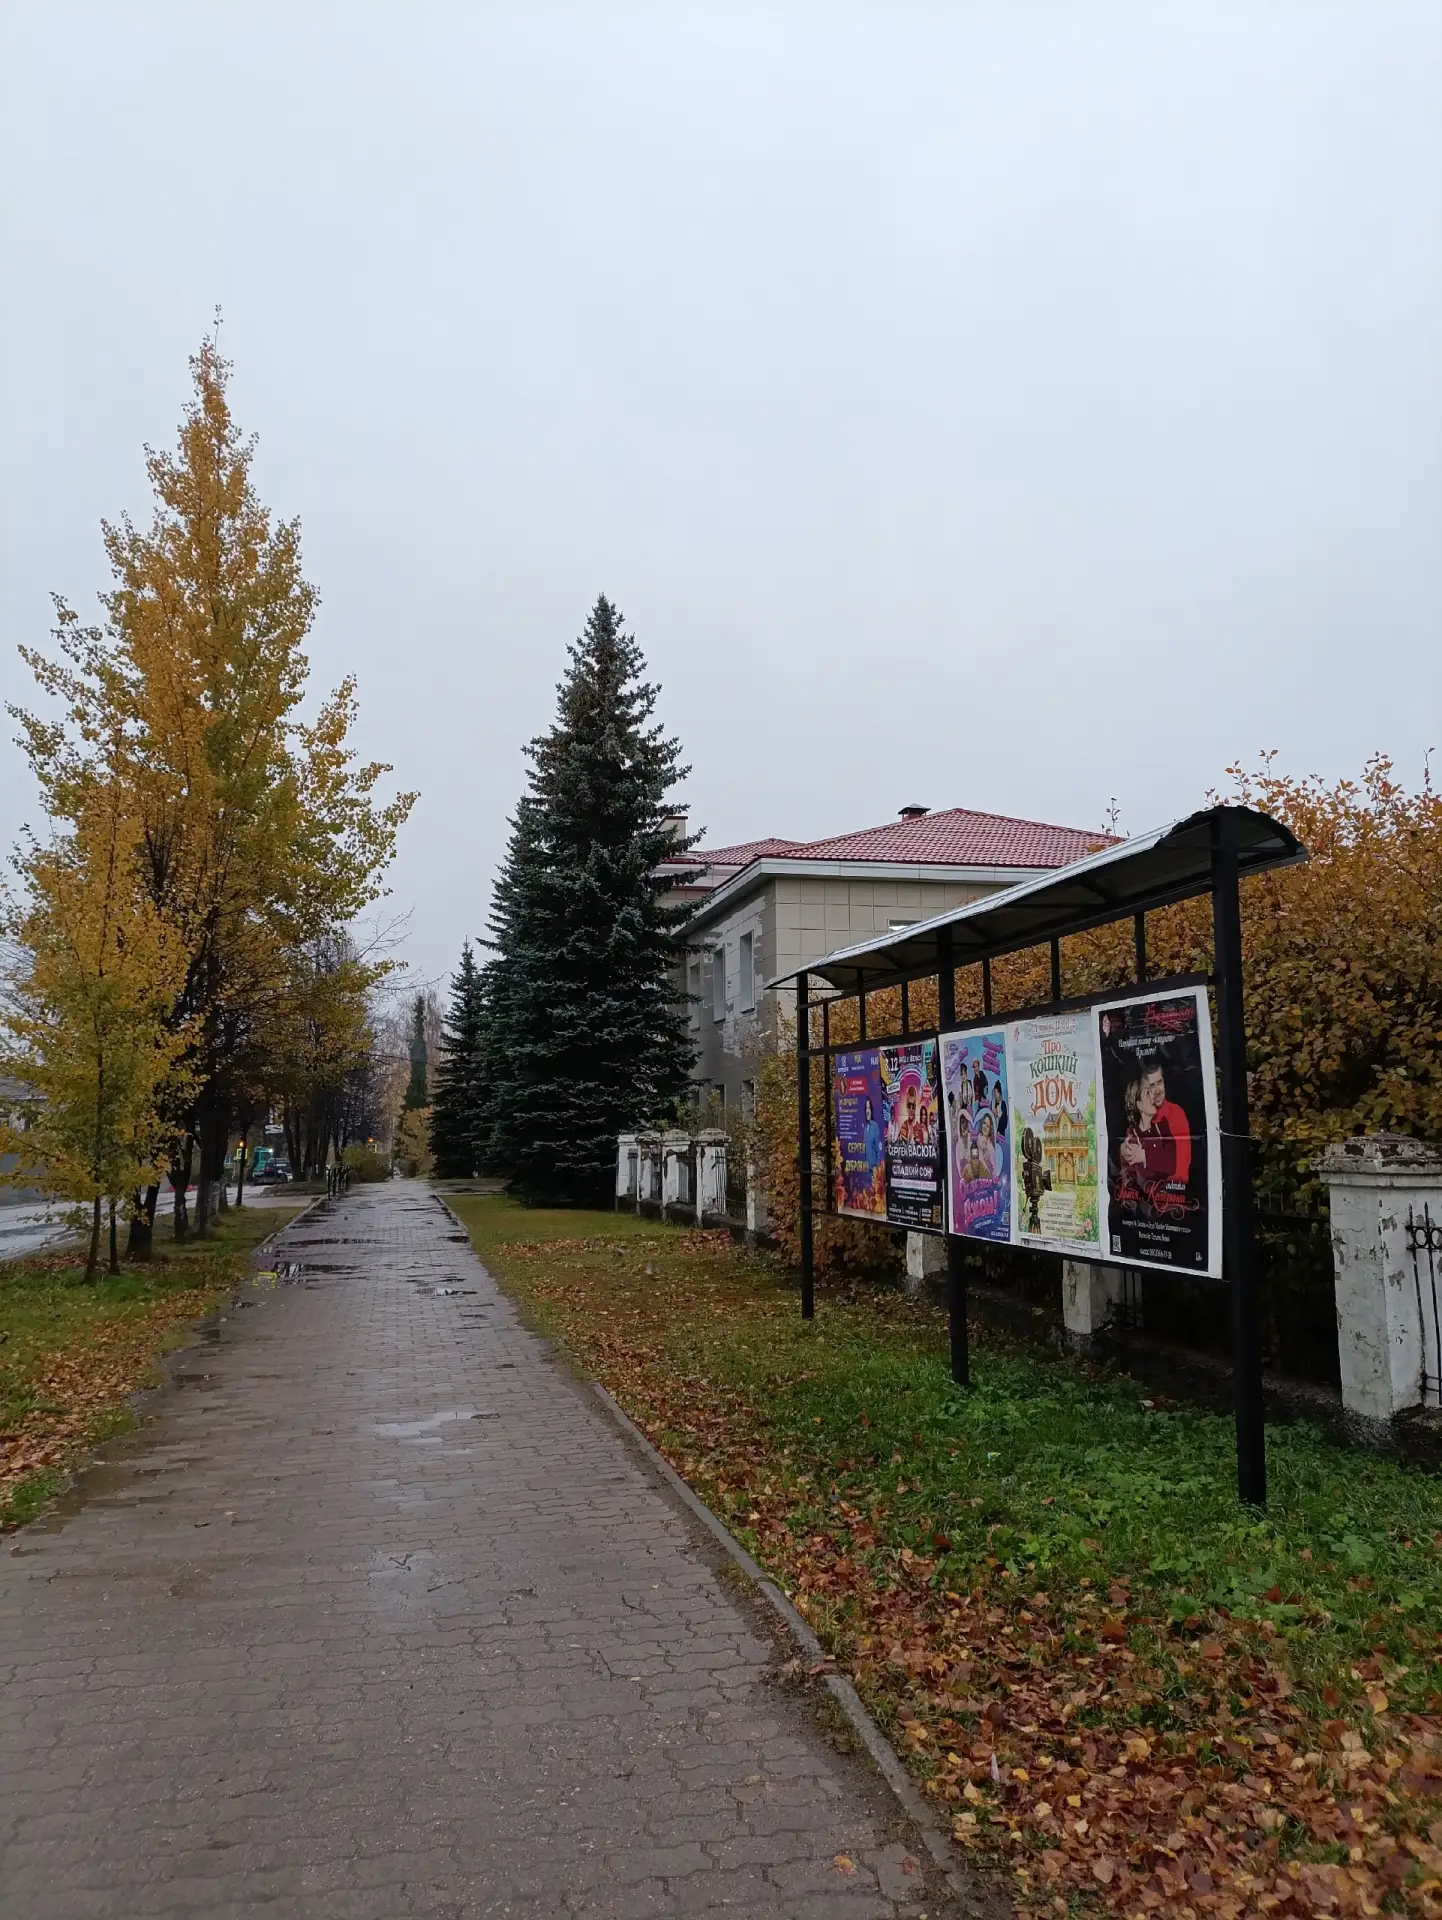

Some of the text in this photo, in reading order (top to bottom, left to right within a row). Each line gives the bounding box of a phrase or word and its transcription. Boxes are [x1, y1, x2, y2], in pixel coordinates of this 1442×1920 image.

[1041, 1039, 1062, 1055] Про
[1031, 1075, 1077, 1115] ДОМ
[908, 1145, 937, 1158] ВАСЮТА
[892, 1164, 919, 1176] СЛАДКИЙ
